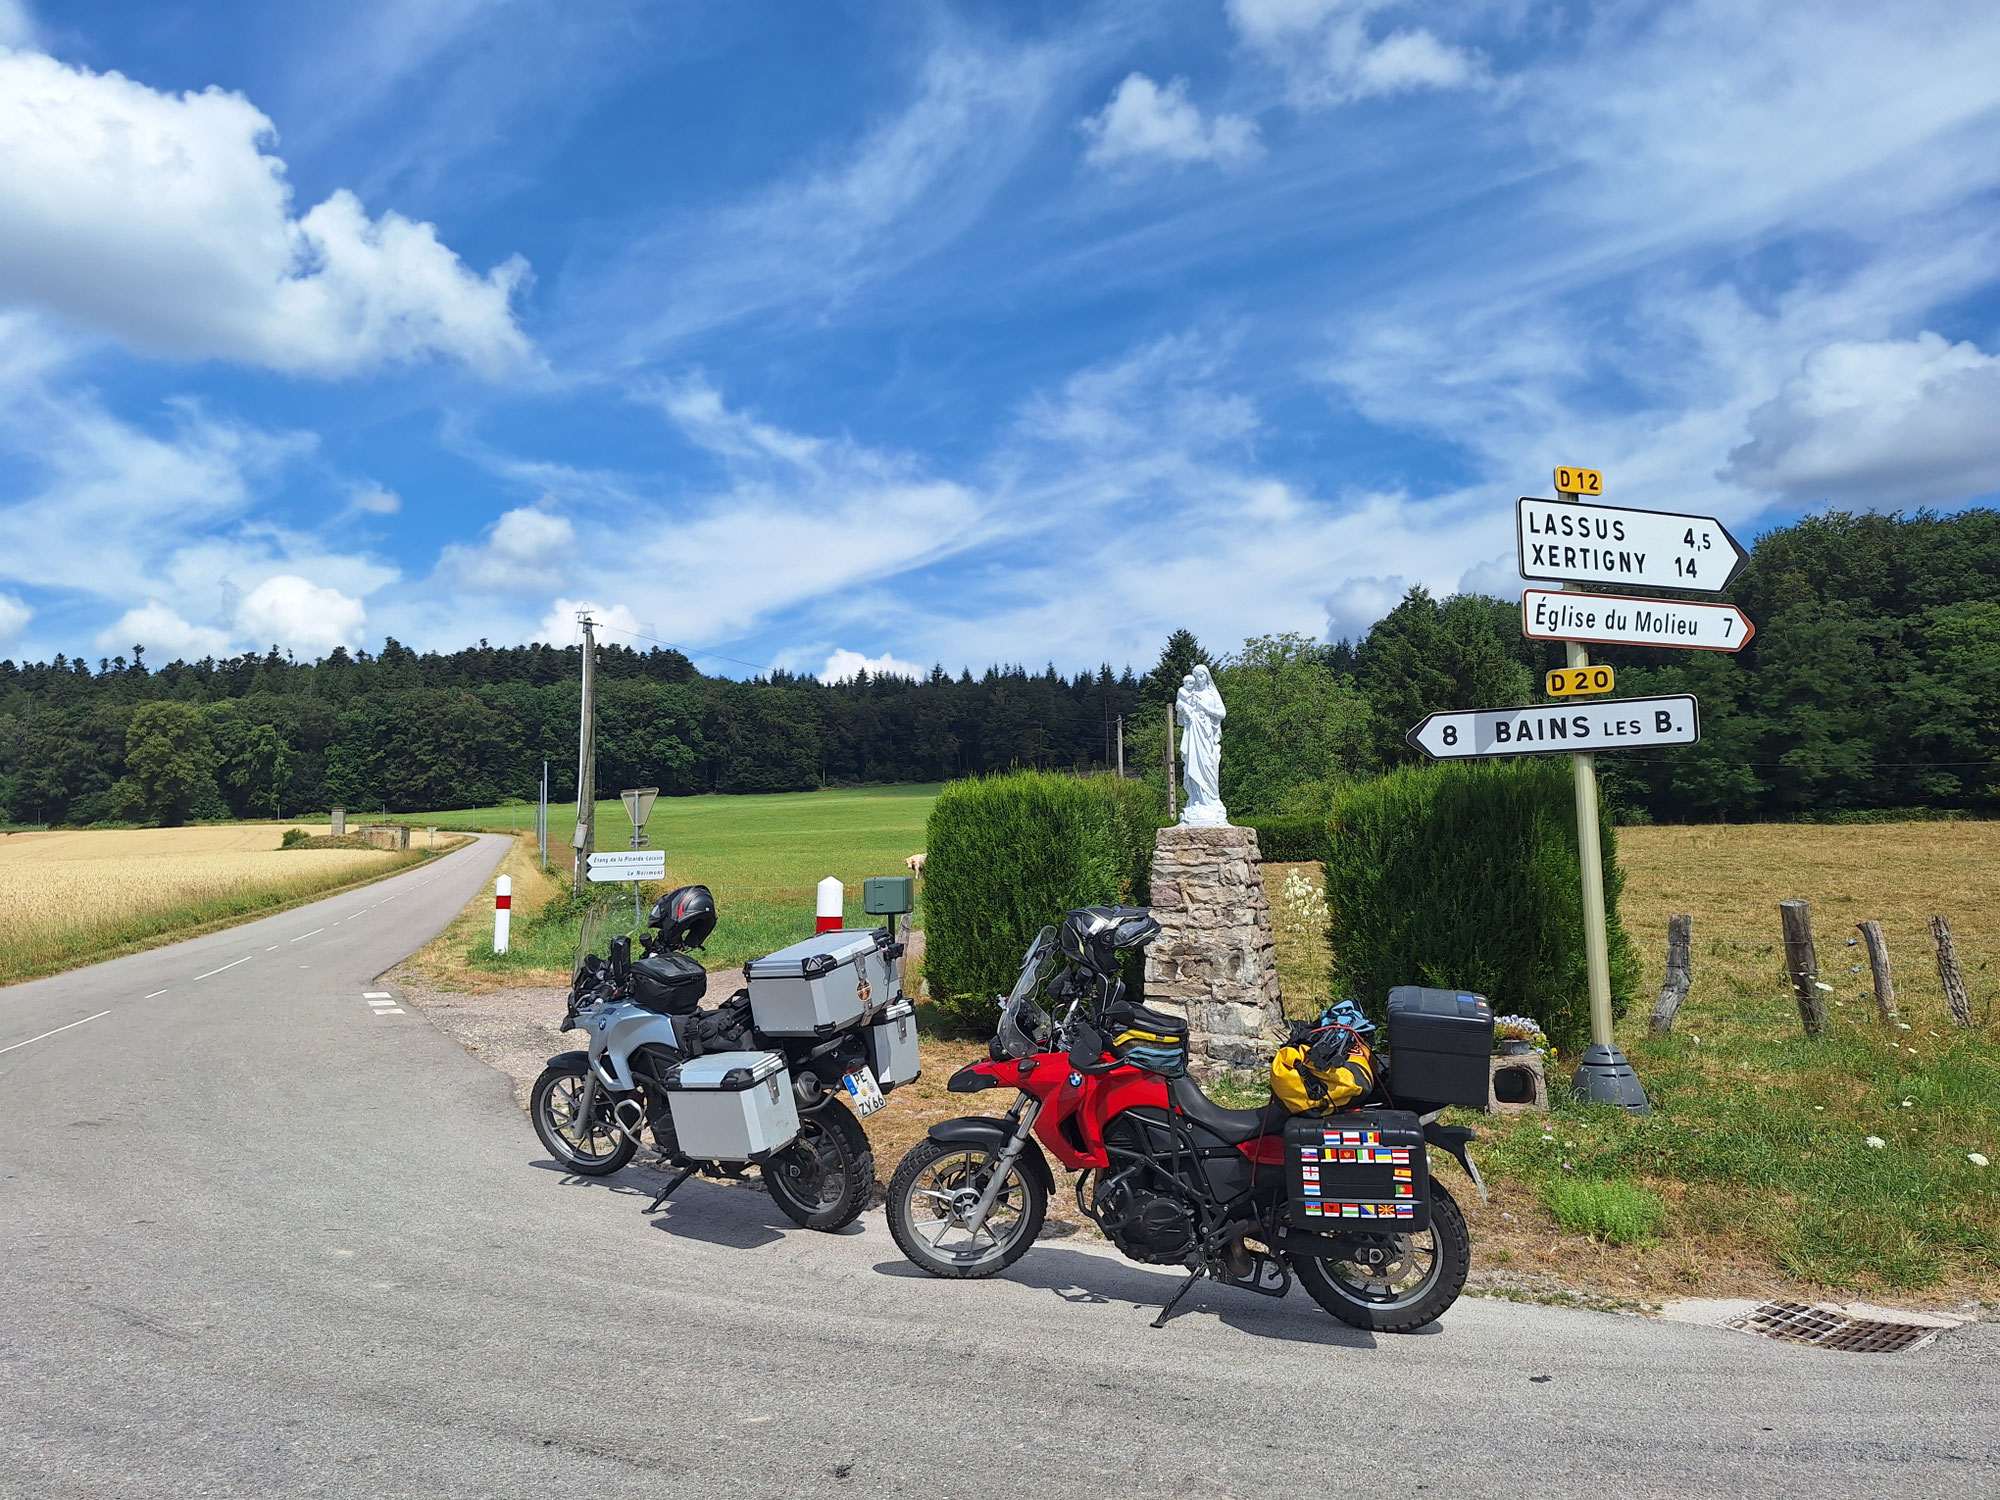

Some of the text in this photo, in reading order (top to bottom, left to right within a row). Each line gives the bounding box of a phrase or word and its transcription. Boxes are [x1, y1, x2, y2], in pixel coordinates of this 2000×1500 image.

[1560, 470, 1599, 491] D 12
[1529, 511, 1711, 552] LASSUS 4,5
[1532, 543, 1697, 578] XERTIGNY 14
[1535, 596, 1733, 638] Église du Molieu 7
[1551, 670, 1609, 692] D 20
[1442, 710, 1683, 746] 8 BAINS LES B.
[853, 1070, 868, 1085] PE
